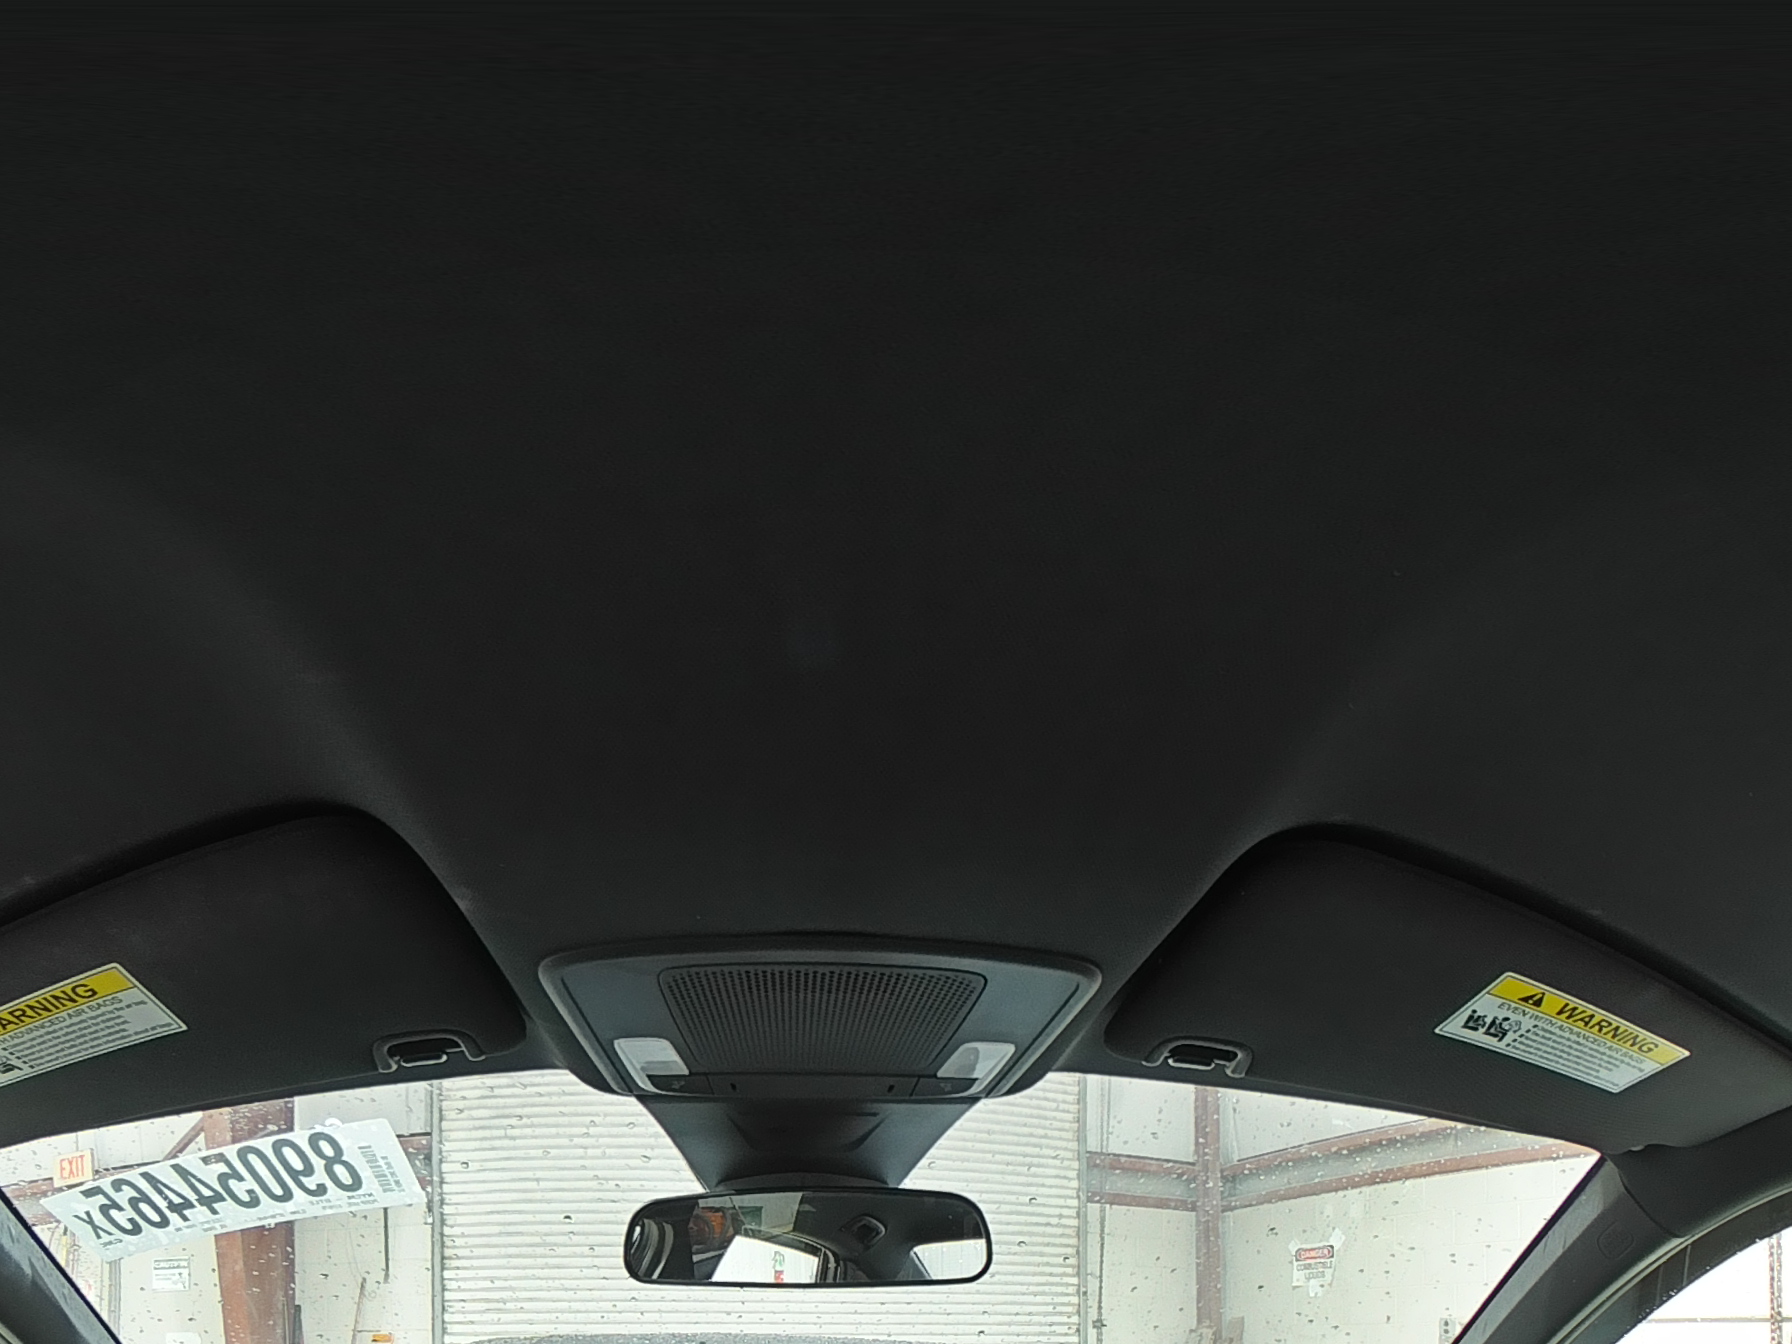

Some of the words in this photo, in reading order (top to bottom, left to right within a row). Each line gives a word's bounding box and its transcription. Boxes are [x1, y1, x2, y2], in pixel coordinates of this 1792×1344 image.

[8, 1014, 67, 1041] ADVANCED
[68, 1008, 88, 1020] AIR
[87, 995, 123, 1012] BAGS
[1497, 1001, 1530, 1017] EVEN
[1529, 1012, 1557, 1028] WITH
[1555, 1023, 1608, 1047] ADVANCED
[1605, 1044, 1623, 1055] AIR
[1620, 1050, 1646, 1064] BAGS
[1555, 1002, 1659, 1054] WARNING
[59, 1155, 85, 1180] EXIT
